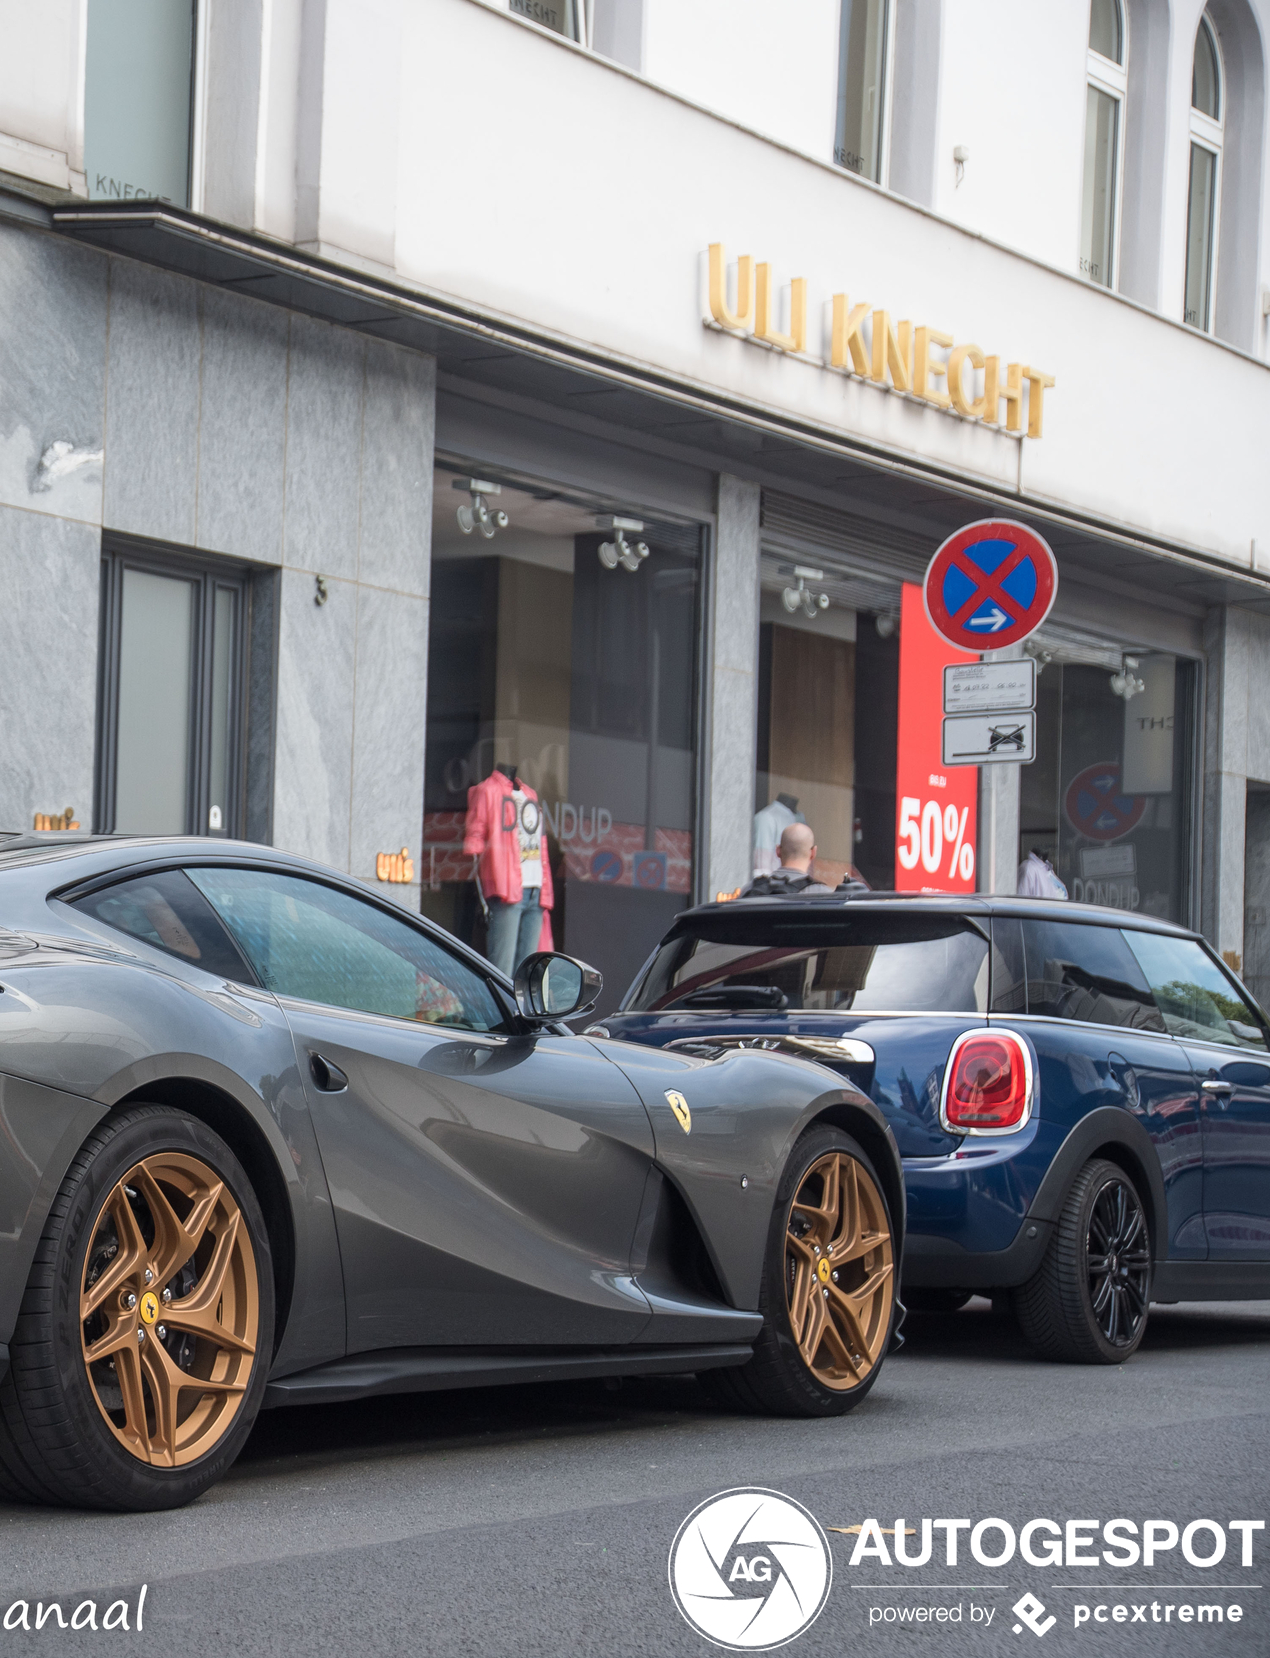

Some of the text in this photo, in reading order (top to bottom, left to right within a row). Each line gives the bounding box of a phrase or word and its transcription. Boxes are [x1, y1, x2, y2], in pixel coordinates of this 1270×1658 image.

[510, 0, 557, 25] NECHT
[96, 173, 171, 200] KNEC
[707, 241, 1056, 439] ULI KNECHT
[501, 795, 613, 845] DONDUP
[897, 796, 975, 881] 50%
